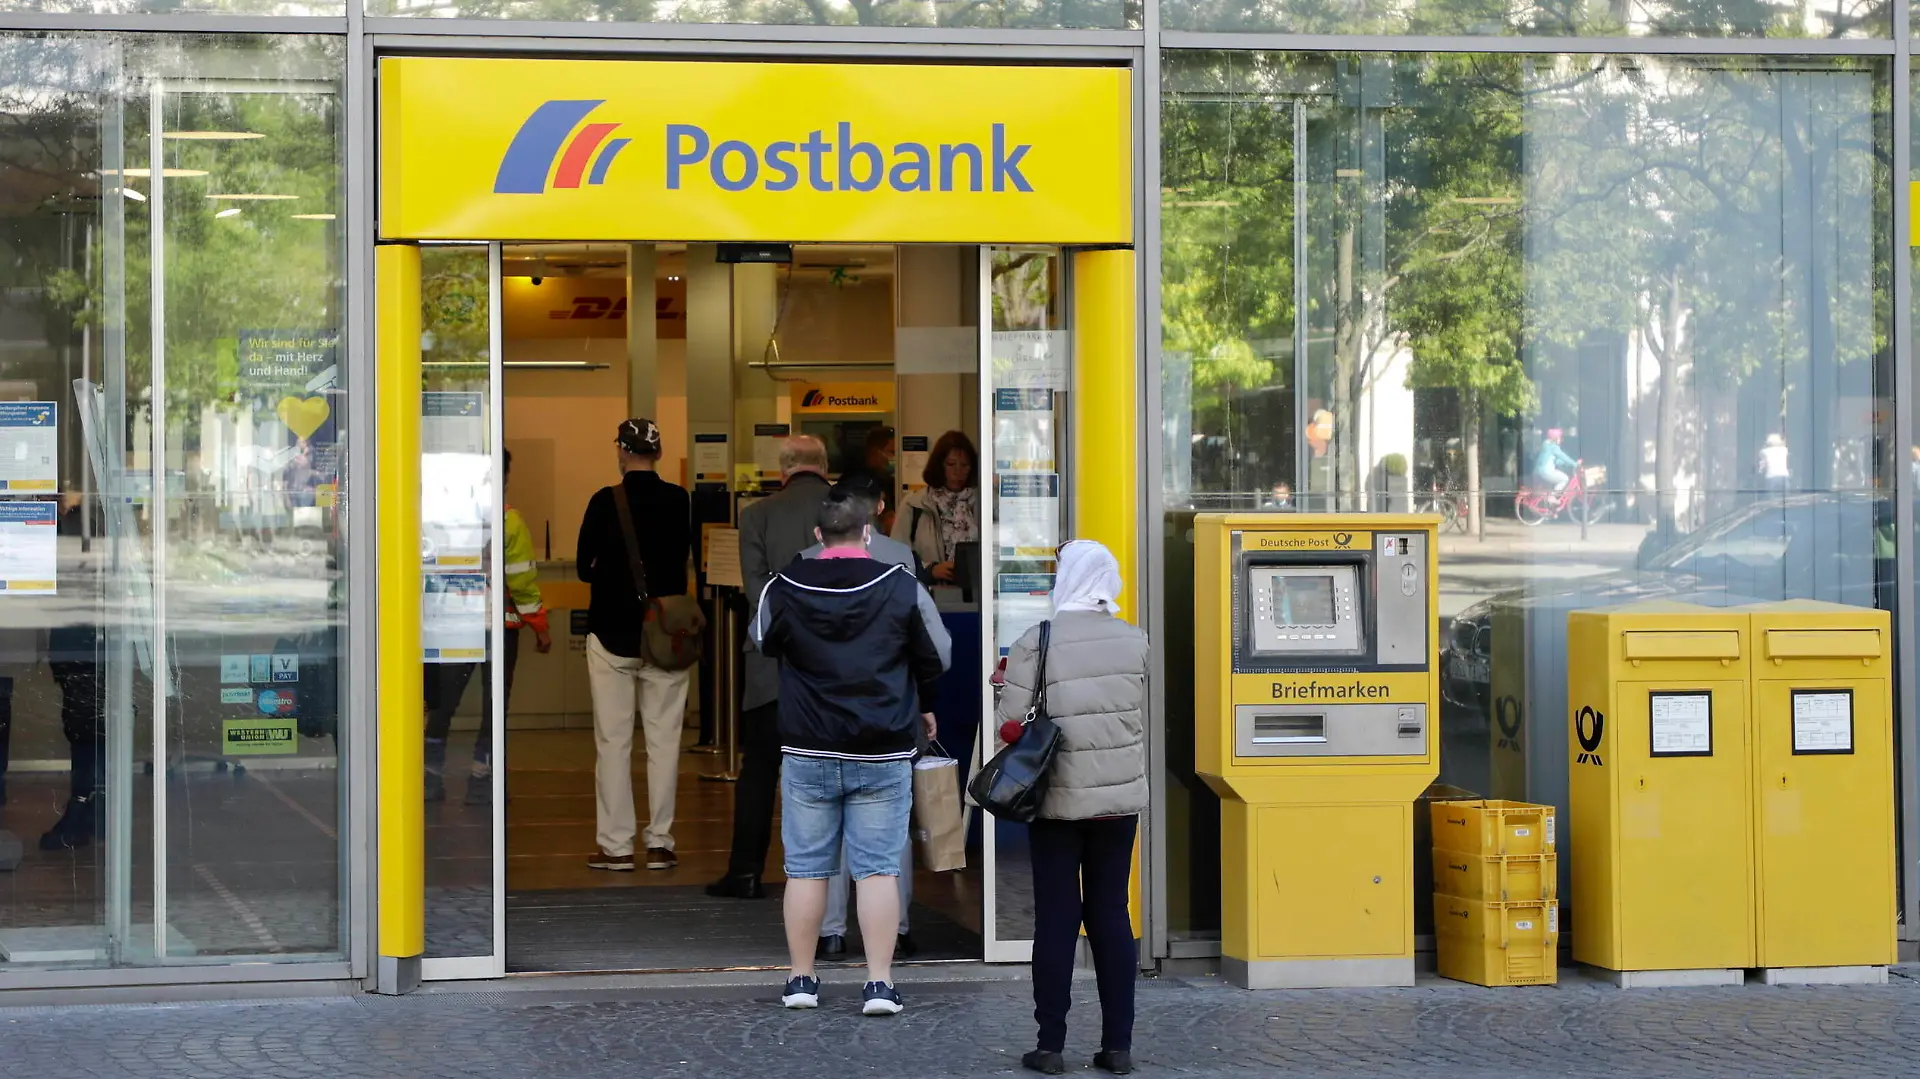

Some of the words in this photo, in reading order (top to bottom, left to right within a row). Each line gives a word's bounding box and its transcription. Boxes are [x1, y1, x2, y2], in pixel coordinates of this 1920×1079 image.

[665, 121, 1035, 192] Postbank
[249, 337, 269, 348] Wir
[271, 337, 295, 348] sind
[249, 352, 263, 362] da
[275, 352, 294, 362] mit
[297, 352, 324, 362] Herz
[249, 366, 271, 376] und
[274, 366, 308, 376] Hand!
[828, 394, 878, 406] Postbank
[1260, 538, 1306, 547] Deutsche
[1308, 538, 1329, 547] Post
[280, 658, 291, 670] V
[1272, 681, 1390, 698] Briefmarken
